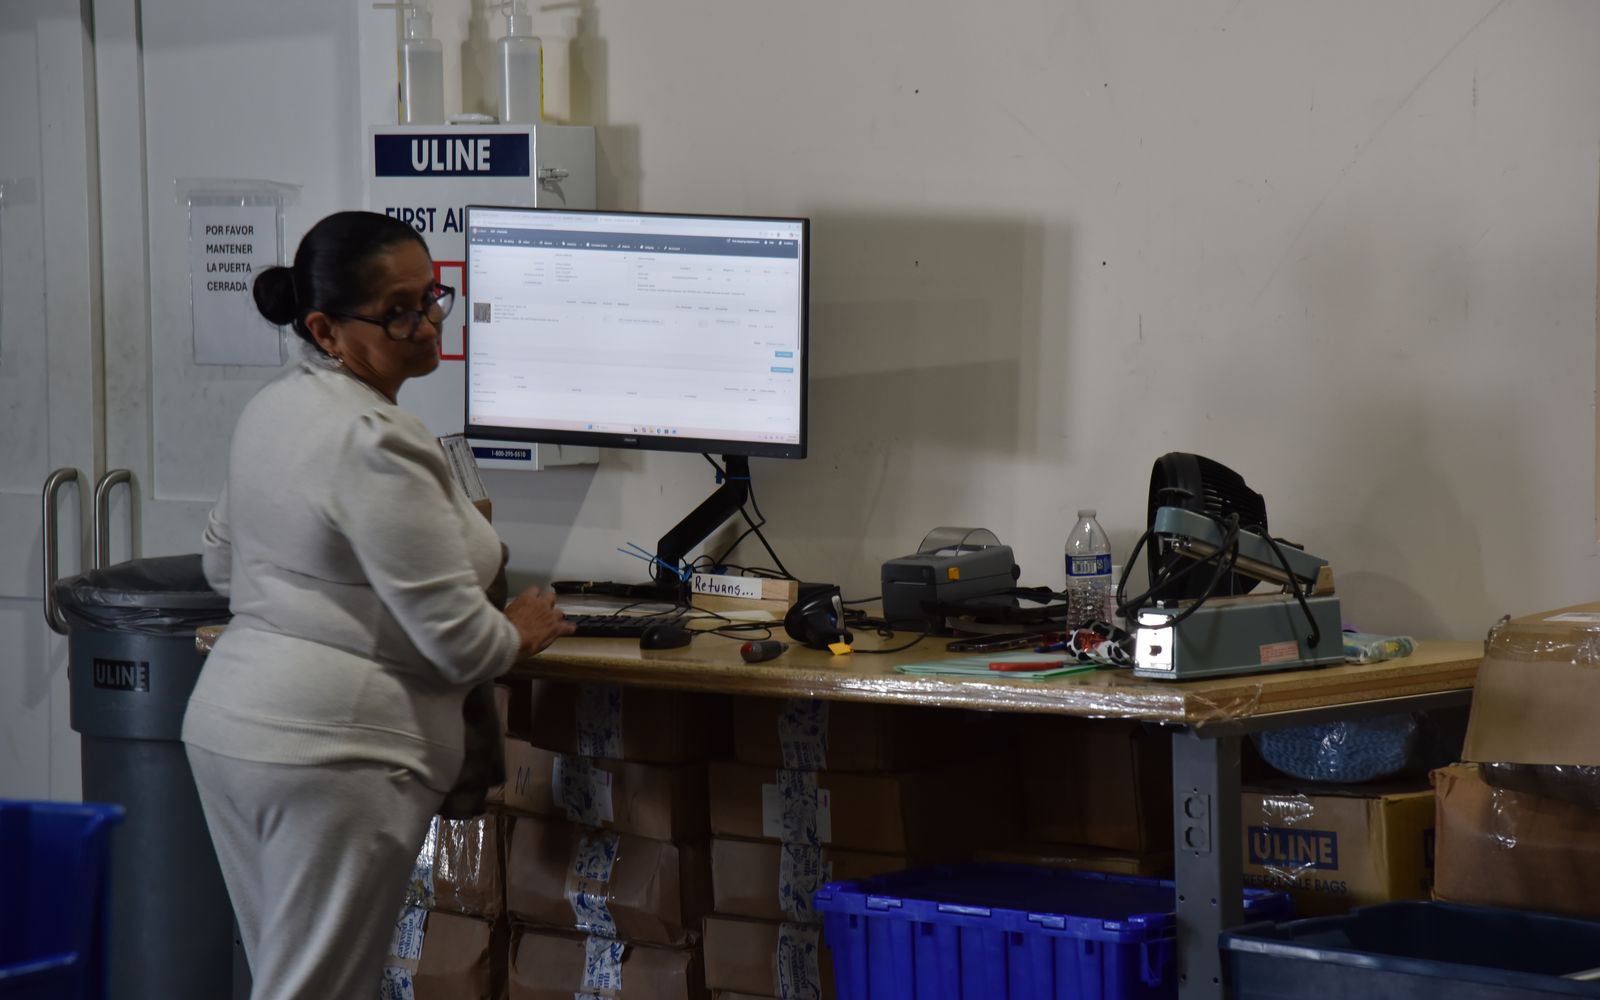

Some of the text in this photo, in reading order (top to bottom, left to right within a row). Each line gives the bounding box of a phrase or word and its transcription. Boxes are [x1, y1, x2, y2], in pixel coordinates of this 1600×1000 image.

[412, 139, 490, 171] ULINE
[443, 207, 463, 233] AI
[206, 225, 254, 236] POR FAVOR
[206, 243, 253, 254] MANTENER
[207, 262, 252, 273] LA PUERTA
[207, 281, 248, 292] CERRADA
[96, 663, 146, 689] ULINE
[1254, 831, 1333, 865] ULINE
[1315, 879, 1348, 895] BAGS
